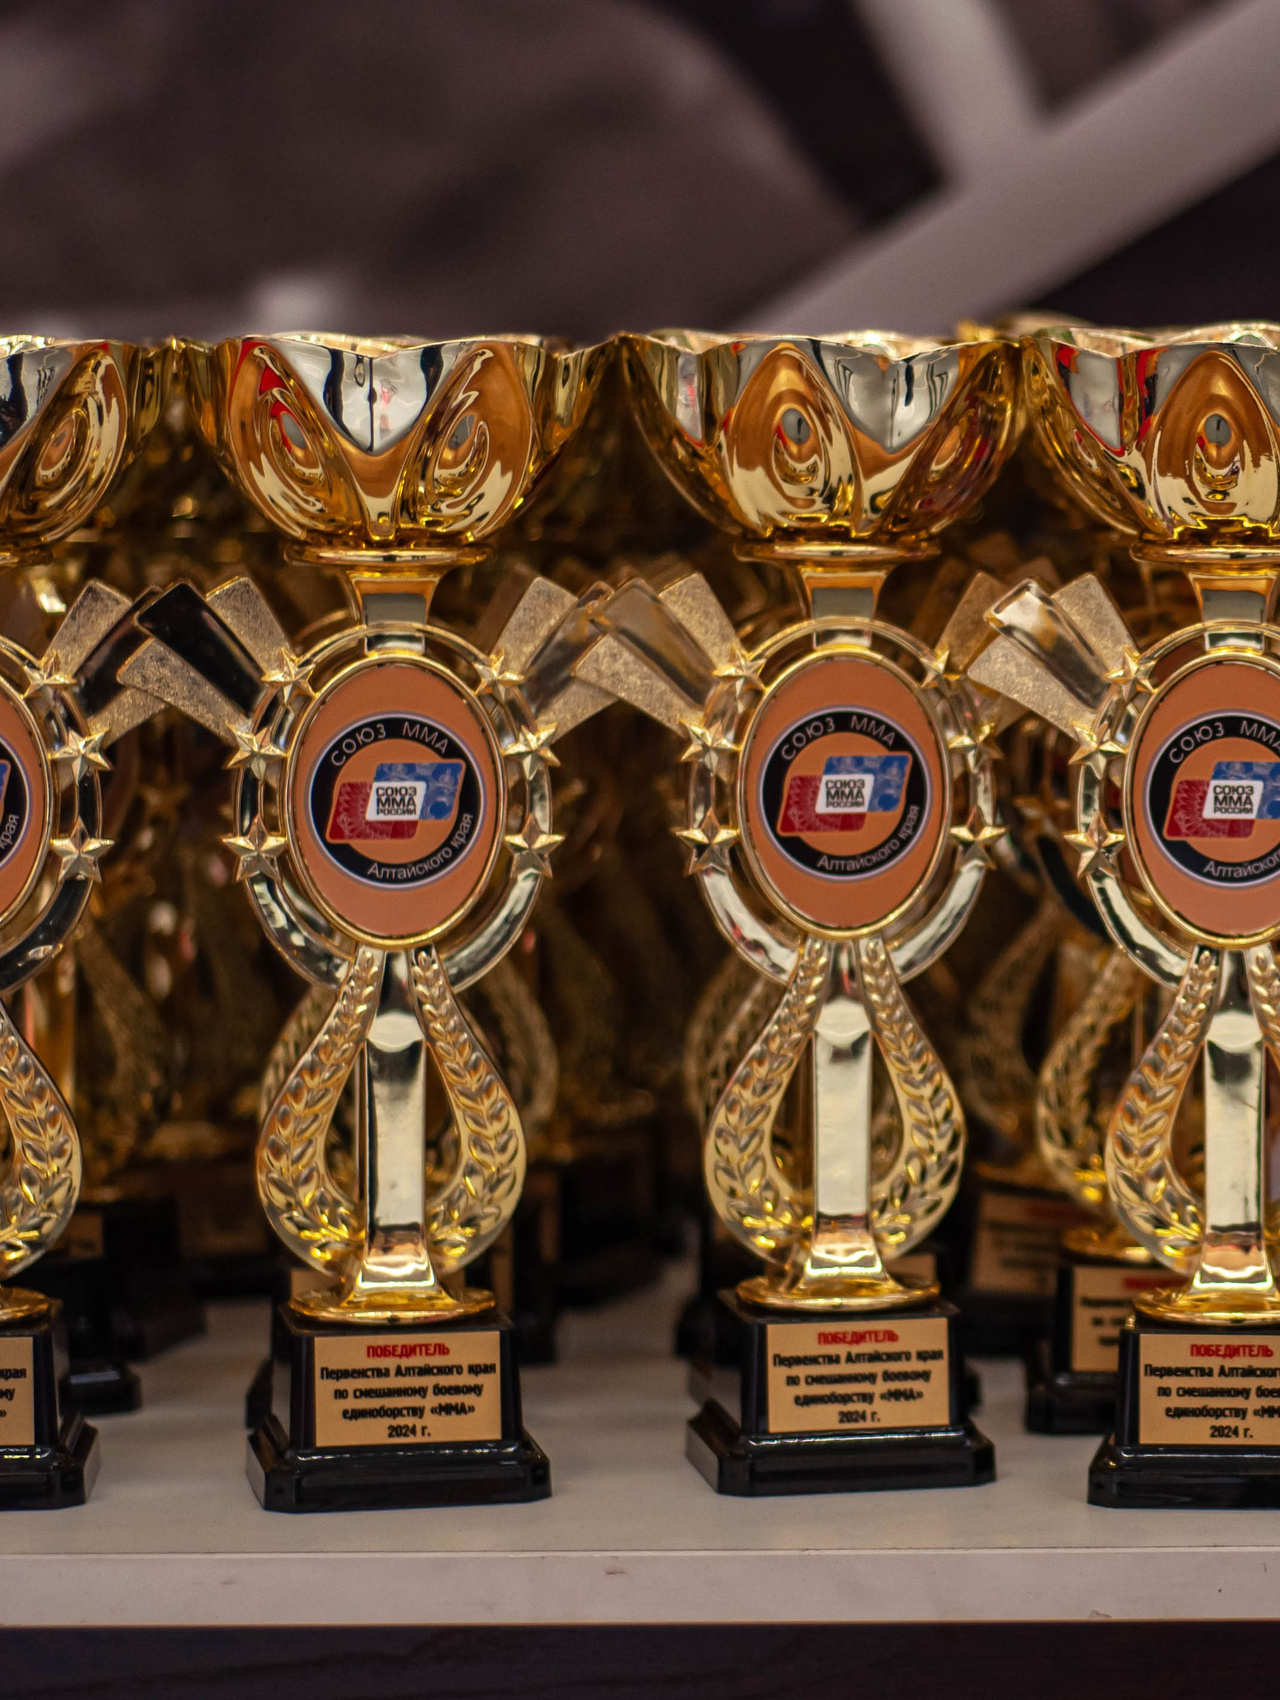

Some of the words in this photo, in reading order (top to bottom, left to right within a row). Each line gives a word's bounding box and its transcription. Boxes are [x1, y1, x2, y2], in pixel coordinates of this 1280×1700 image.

[331, 724, 386, 767] СОЮЗ
[402, 722, 448, 754] ММА
[781, 717, 835, 761] СОЮЗ
[851, 715, 896, 747] ММА
[1169, 722, 1224, 764] СОЮЗ
[376, 786, 417, 797] СОЮЗ
[825, 779, 865, 790] СОЮЗ
[1213, 785, 1254, 796] СОЮЗ
[376, 798, 416, 808] ММА
[825, 790, 865, 801] ММА
[1213, 796, 1253, 807] ММА
[376, 808, 417, 816] РОССИИ
[1213, 806, 1253, 814] РОССИИ
[817, 839, 900, 872] Алтайского
[898, 805, 920, 840] края
[367, 848, 453, 880] Алтайского
[452, 813, 474, 849] края
[818, 1330, 899, 1345] ПОБЕДИТЕЛЬ
[366, 1343, 450, 1358] ПОБЕДИТЕЛЬ
[1190, 1344, 1274, 1359] ПОБЕДИТЕЛЬ
[773, 1353, 840, 1368] Первенства
[845, 1351, 911, 1364] Алтайского
[916, 1350, 944, 1362] края
[320, 1366, 390, 1381] Первенства
[395, 1364, 463, 1377] Алтайского
[468, 1363, 496, 1377] края
[1144, 1364, 1213, 1379] Первенства
[786, 1375, 800, 1386] по
[334, 1388, 348, 1400] по
[353, 1386, 428, 1399] смешанному
[433, 1383, 483, 1397] боевому
[1157, 1386, 1172, 1397] по
[1176, 1387, 1252, 1400] смешанному
[342, 1405, 424, 1421] единоборству
[430, 1403, 475, 1415] «ММА»
[838, 1410, 867, 1424] 2024
[1165, 1405, 1248, 1420] единоборству
[387, 1425, 417, 1438] 2024
[421, 1426, 431, 1437] г.
[1210, 1425, 1239, 1438] 2024
[1244, 1427, 1254, 1438] г.
